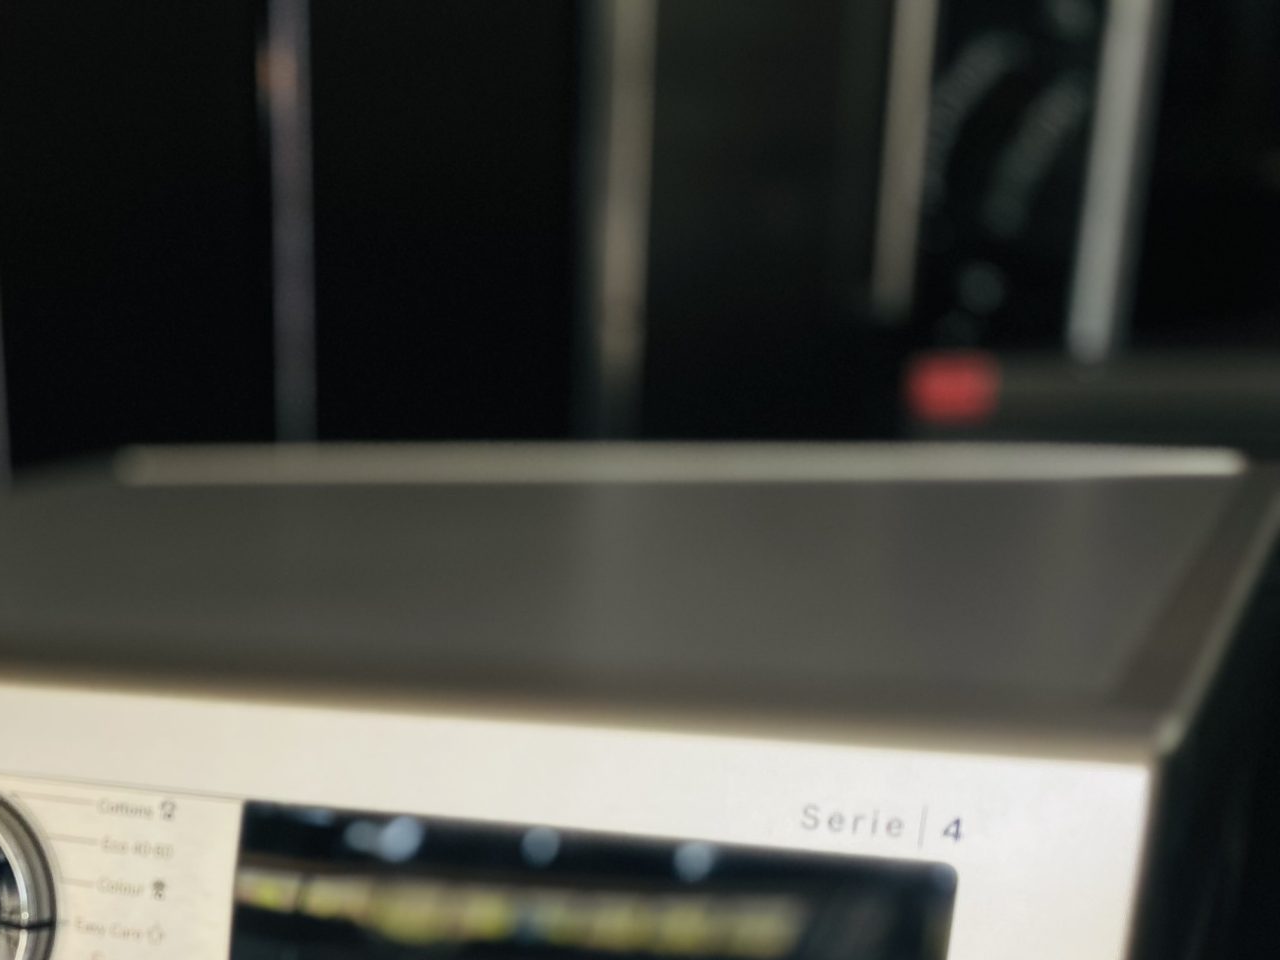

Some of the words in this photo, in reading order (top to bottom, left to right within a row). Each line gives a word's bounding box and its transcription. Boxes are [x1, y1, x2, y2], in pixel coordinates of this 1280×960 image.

[97, 799, 154, 818] Cottons
[801, 803, 905, 838] Serie
[942, 815, 963, 843] 4
[97, 876, 145, 895] Colour
